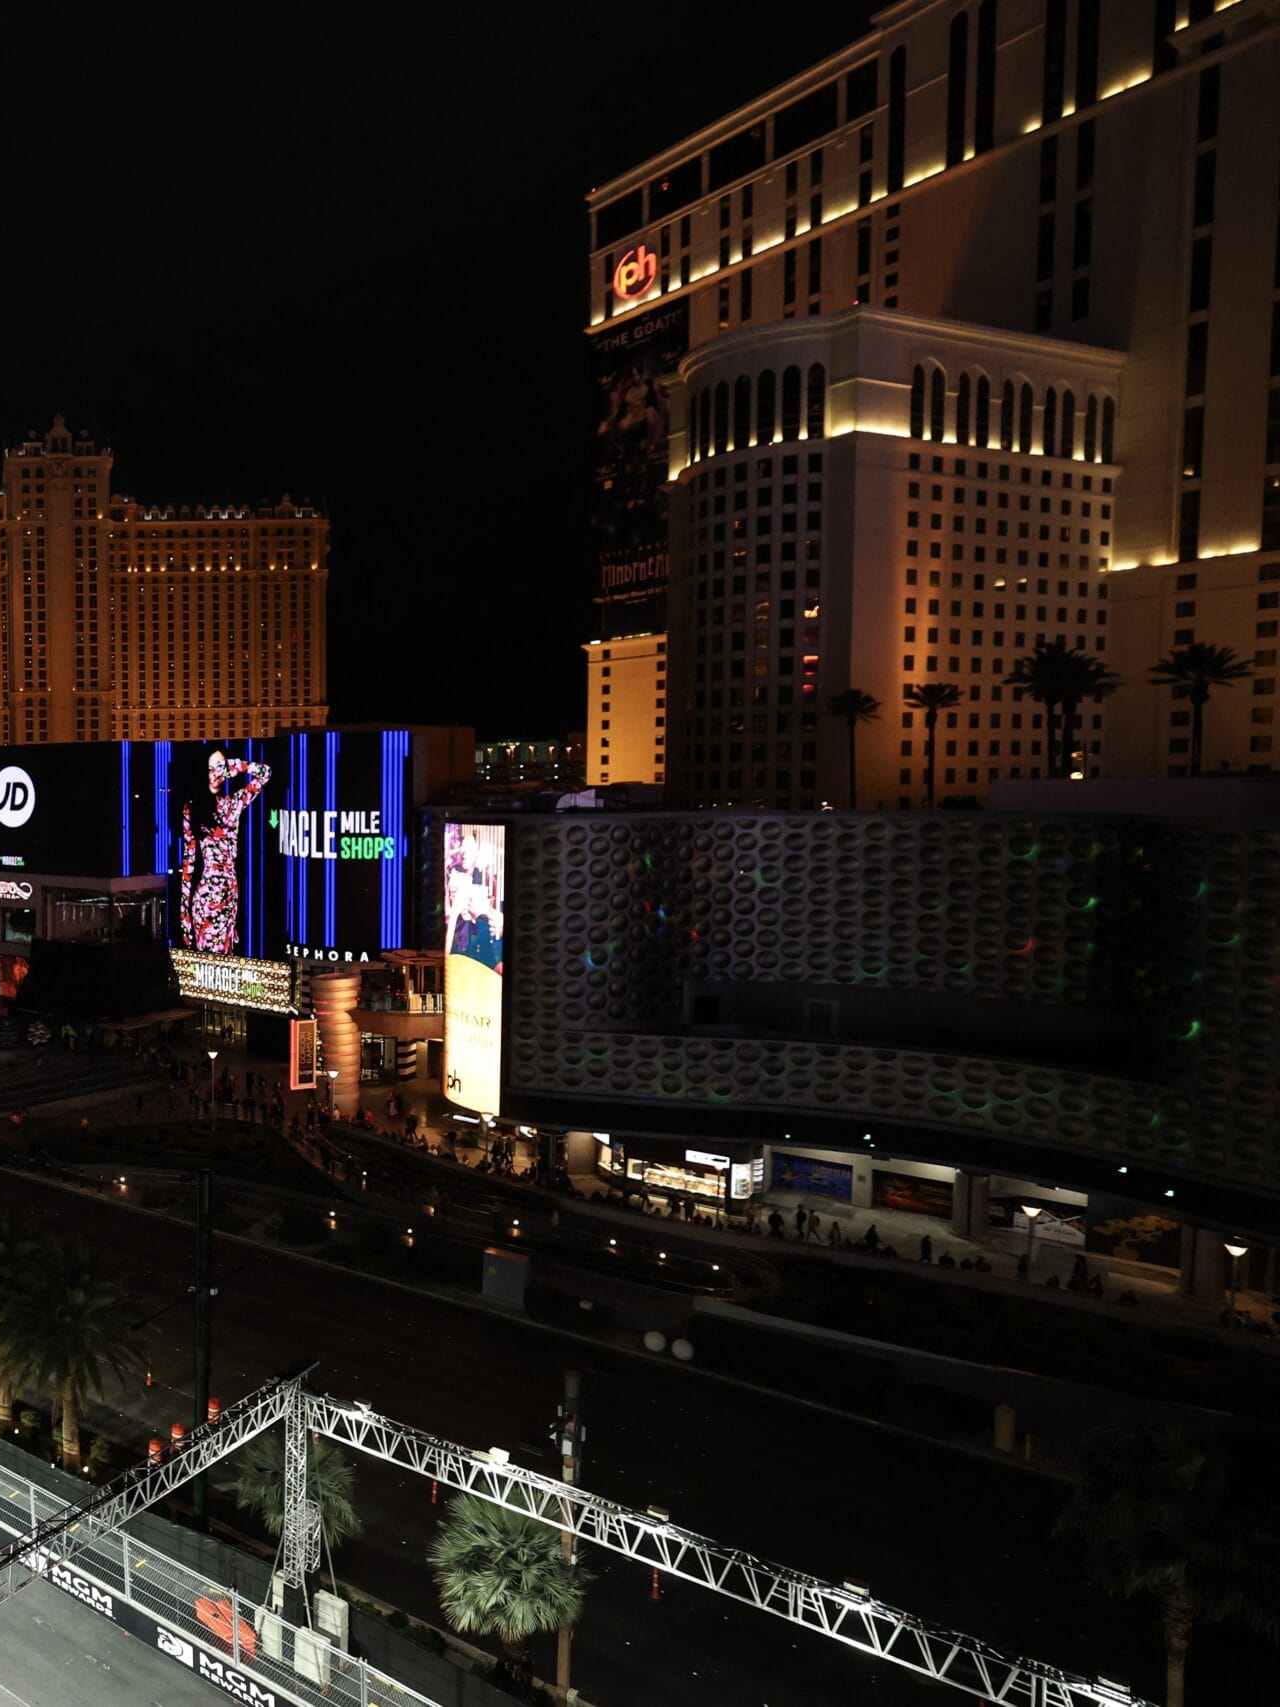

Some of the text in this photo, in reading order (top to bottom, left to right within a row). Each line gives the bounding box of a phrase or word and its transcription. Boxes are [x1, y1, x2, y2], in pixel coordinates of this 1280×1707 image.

[621, 245, 657, 294] ph
[341, 810, 381, 834] MILE
[340, 836, 395, 860] SHOPS
[286, 944, 370, 962] SEPHORA
[194, 963, 259, 993] MIRACLE MILE
[52, 1566, 113, 1610] MGM
[52, 1576, 116, 1620] REWARDS
[199, 1652, 276, 1707] MGM
